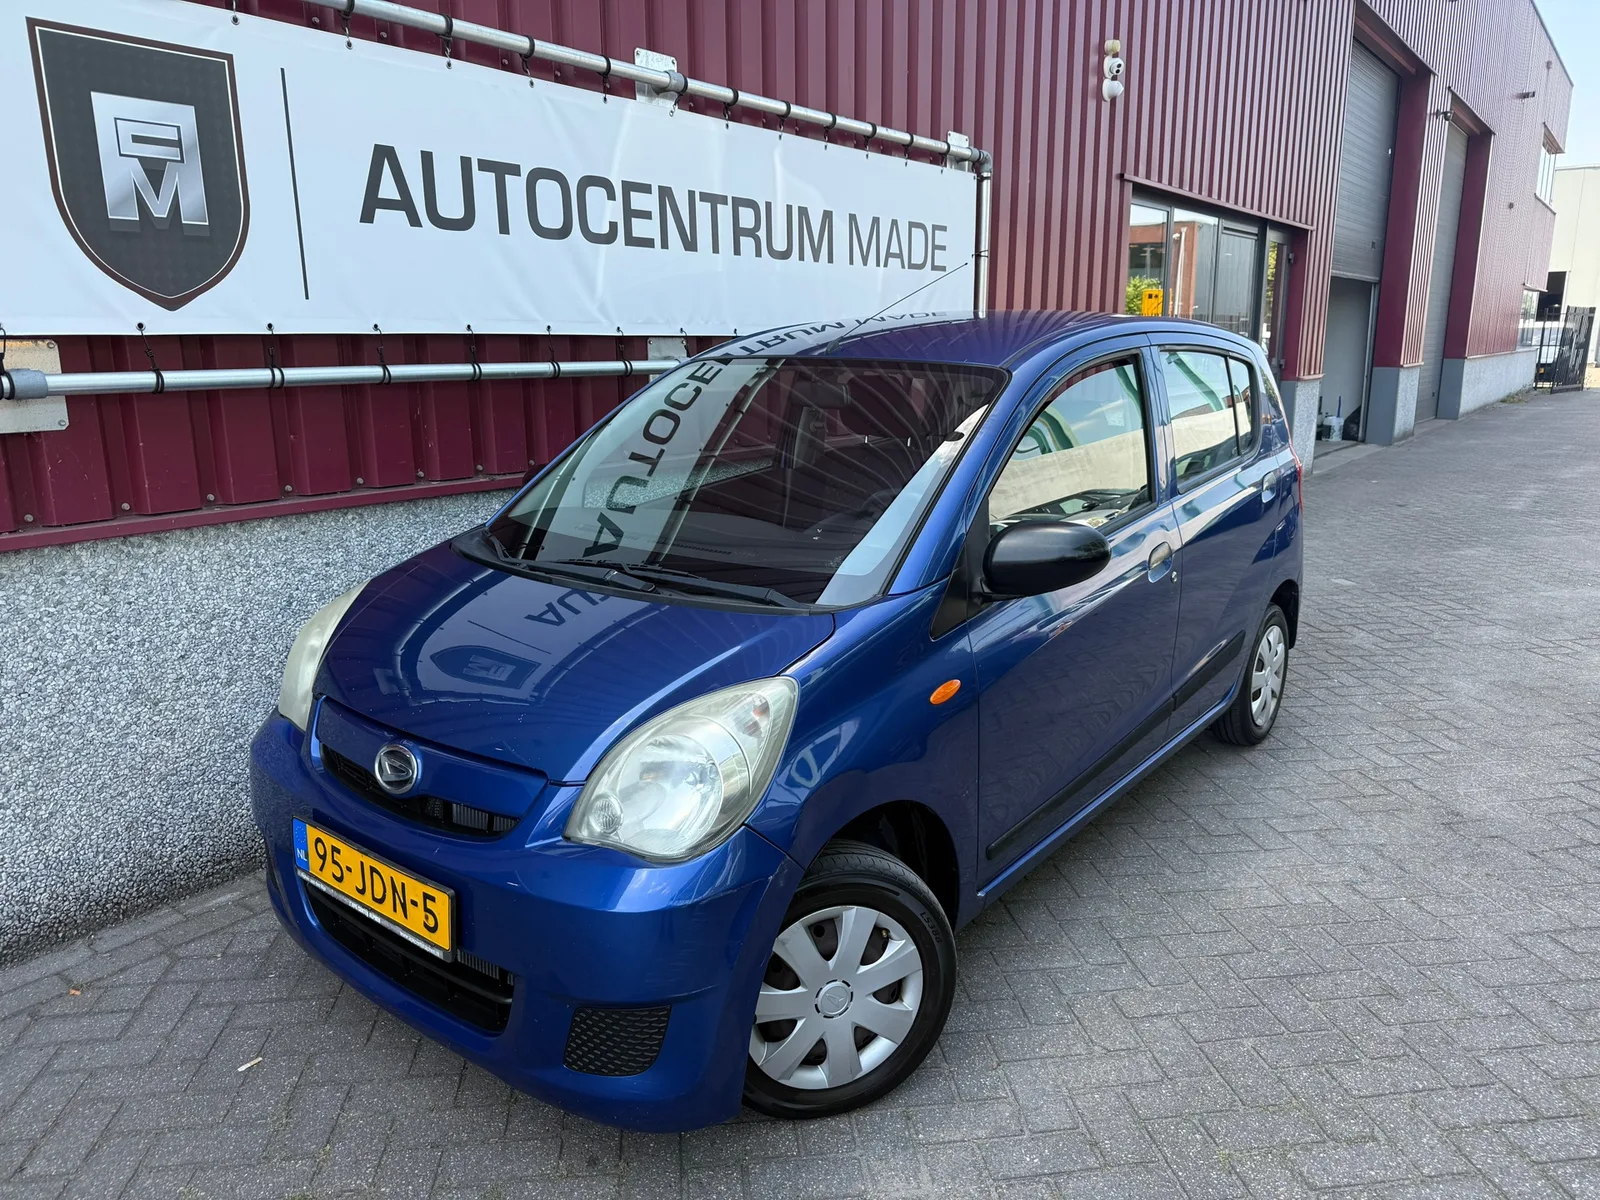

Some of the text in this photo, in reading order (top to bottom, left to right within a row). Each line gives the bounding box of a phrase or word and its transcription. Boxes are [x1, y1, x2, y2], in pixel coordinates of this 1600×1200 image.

[359, 143, 948, 272] AUTOCENTRUM MADE
[297, 848, 308, 862] NL
[314, 837, 439, 934] 95-JDN-5
